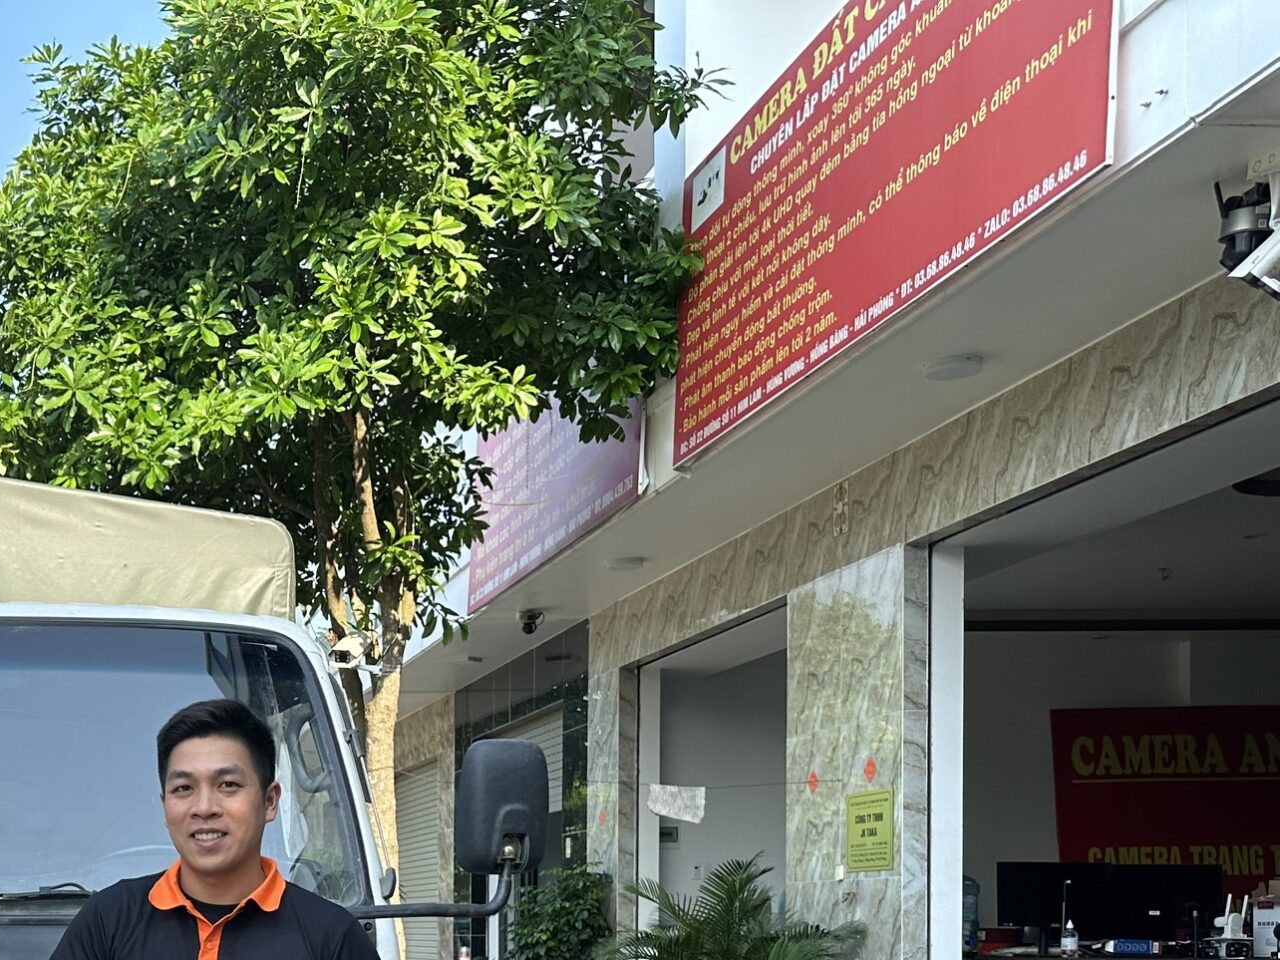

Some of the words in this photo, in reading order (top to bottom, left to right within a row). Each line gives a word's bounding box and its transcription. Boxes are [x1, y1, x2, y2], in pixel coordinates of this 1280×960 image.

[730, 67, 807, 164] CAMERA
[812, 6, 859, 80] ĐẤT
[751, 117, 793, 174] CHUYÊN
[796, 92, 819, 129] LẮP
[821, 62, 846, 103] ĐẶT
[849, 1, 906, 73] CAMERA
[1072, 734, 1228, 776] CAMERA
[1088, 846, 1182, 864] CAMERA
[1190, 845, 1264, 875] TRANG
